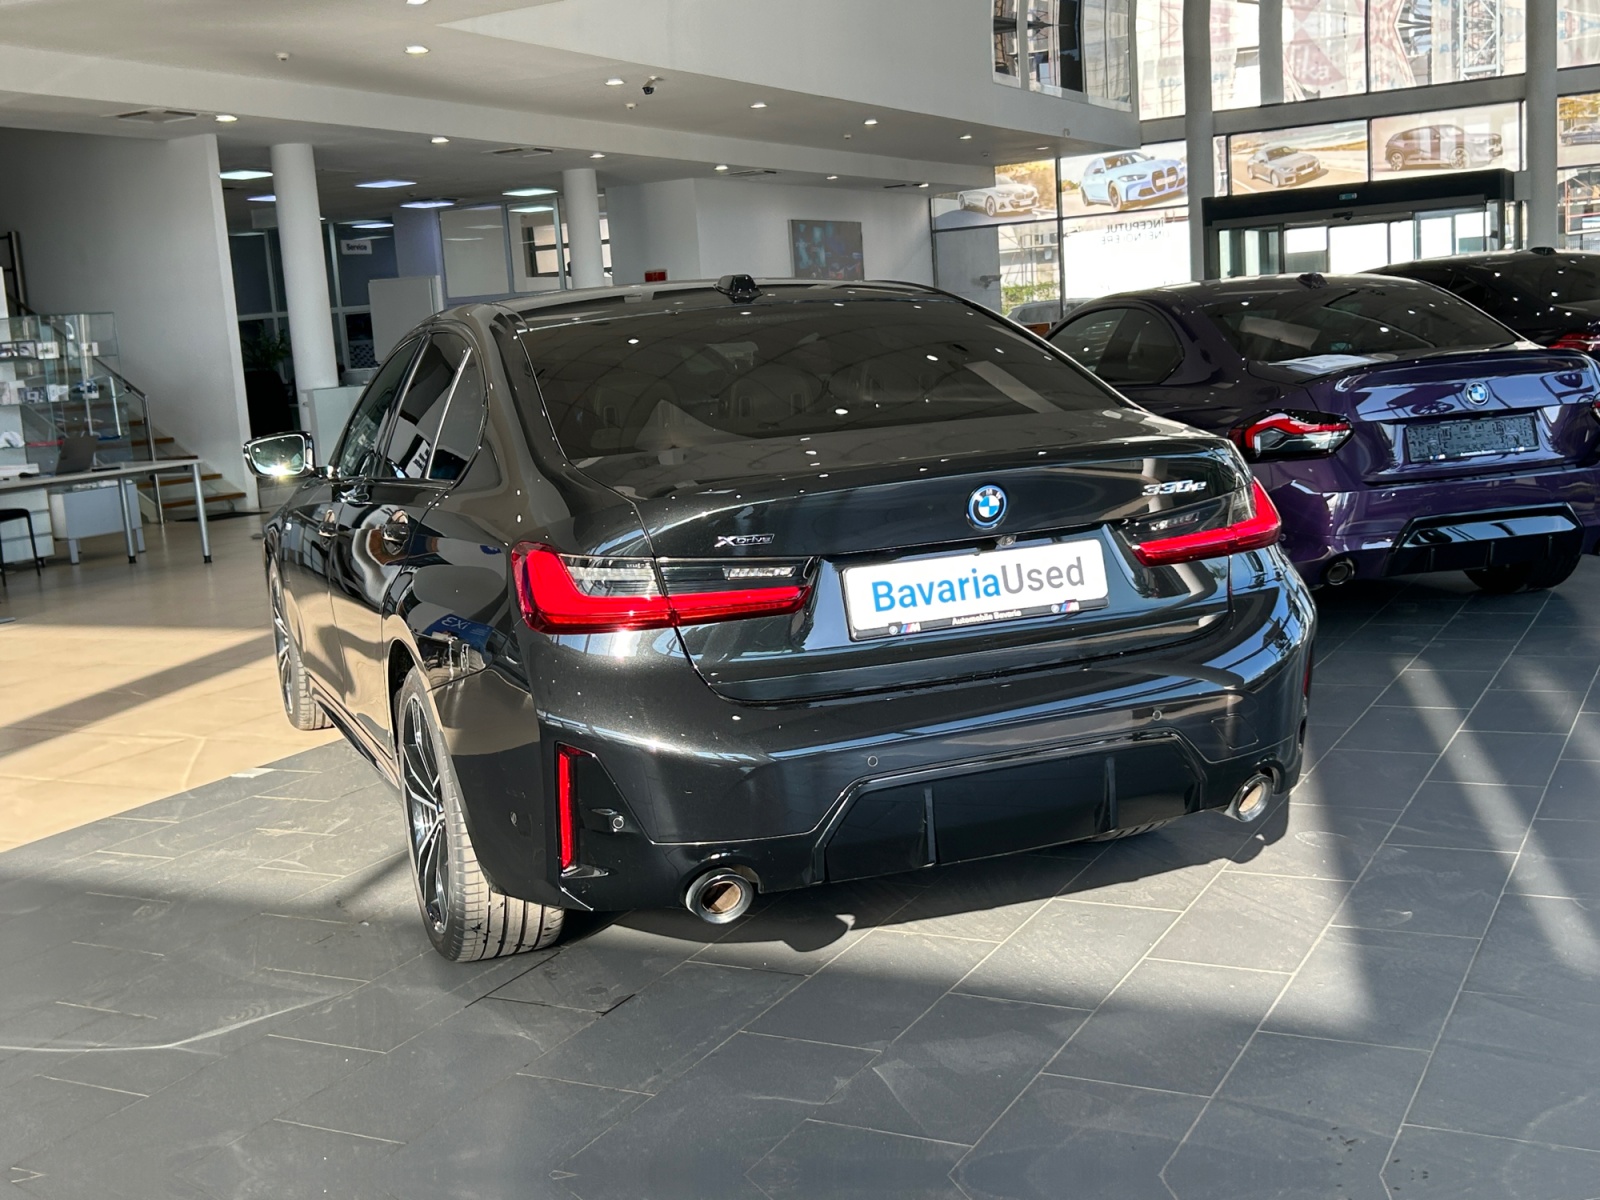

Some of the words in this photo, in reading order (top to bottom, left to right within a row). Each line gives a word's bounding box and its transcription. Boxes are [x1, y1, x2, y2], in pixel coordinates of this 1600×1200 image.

[346, 243, 367, 251] Service
[1142, 480, 1207, 496] 330e
[871, 556, 1085, 612] BavariaUsed
[952, 613, 993, 626] Automobile
[993, 610, 1022, 620] Bavaria
